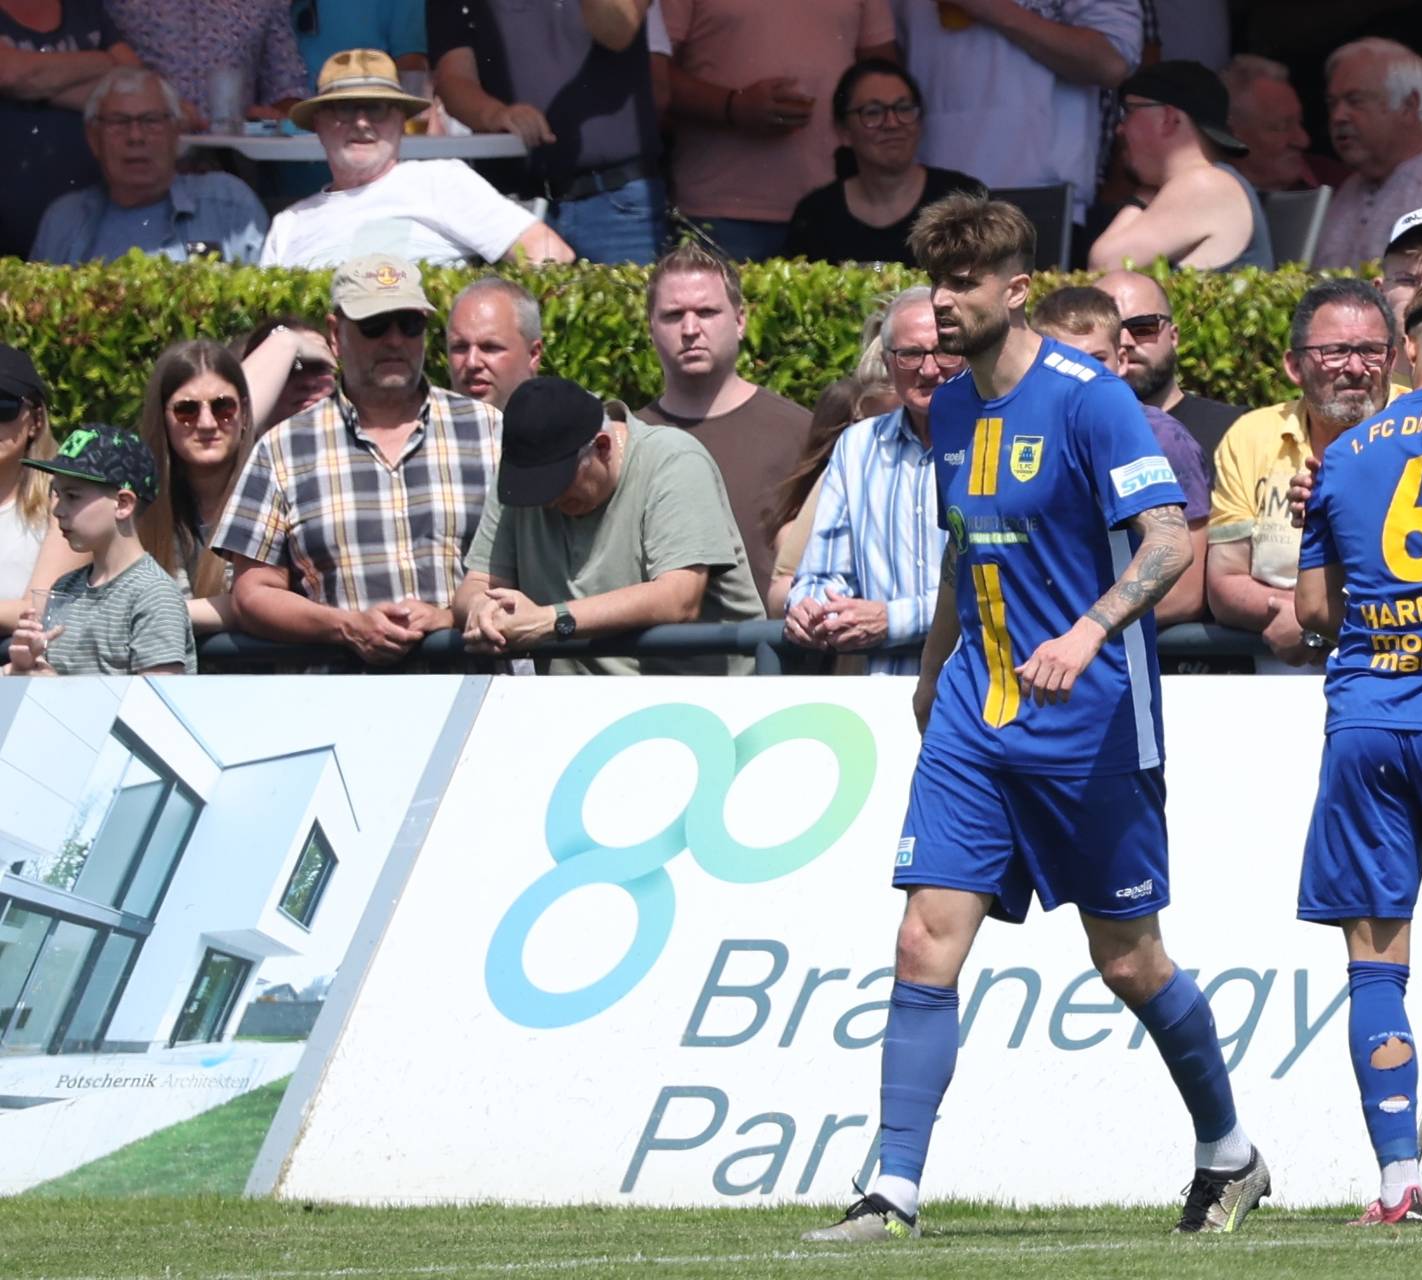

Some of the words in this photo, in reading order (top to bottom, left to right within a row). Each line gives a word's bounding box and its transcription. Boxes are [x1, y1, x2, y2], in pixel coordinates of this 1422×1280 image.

[1369, 418, 1396, 443] FC
[1121, 468, 1175, 494] SWD
[680, 939, 1350, 1080] Branegy
[619, 1085, 942, 1196] Par
